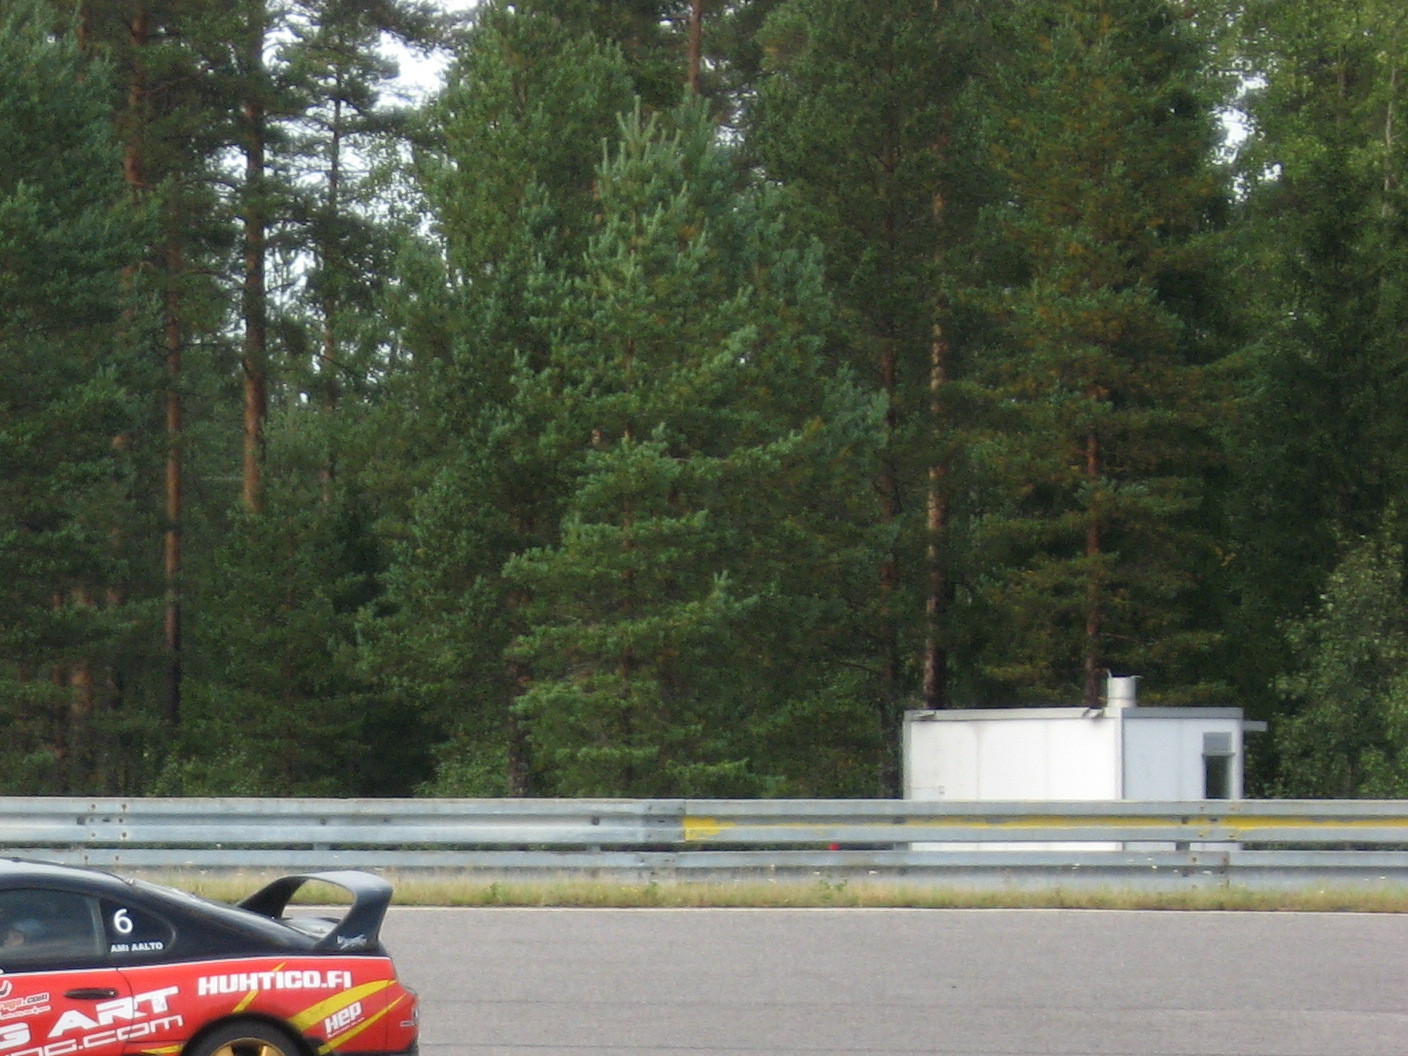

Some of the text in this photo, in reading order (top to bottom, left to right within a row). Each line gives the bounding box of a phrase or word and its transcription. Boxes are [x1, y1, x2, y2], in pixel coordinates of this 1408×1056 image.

[114, 908, 133, 934] 6
[131, 941, 164, 952] AALTO
[197, 970, 352, 996] HUHTICO.FI
[48, 986, 180, 1039] ART
